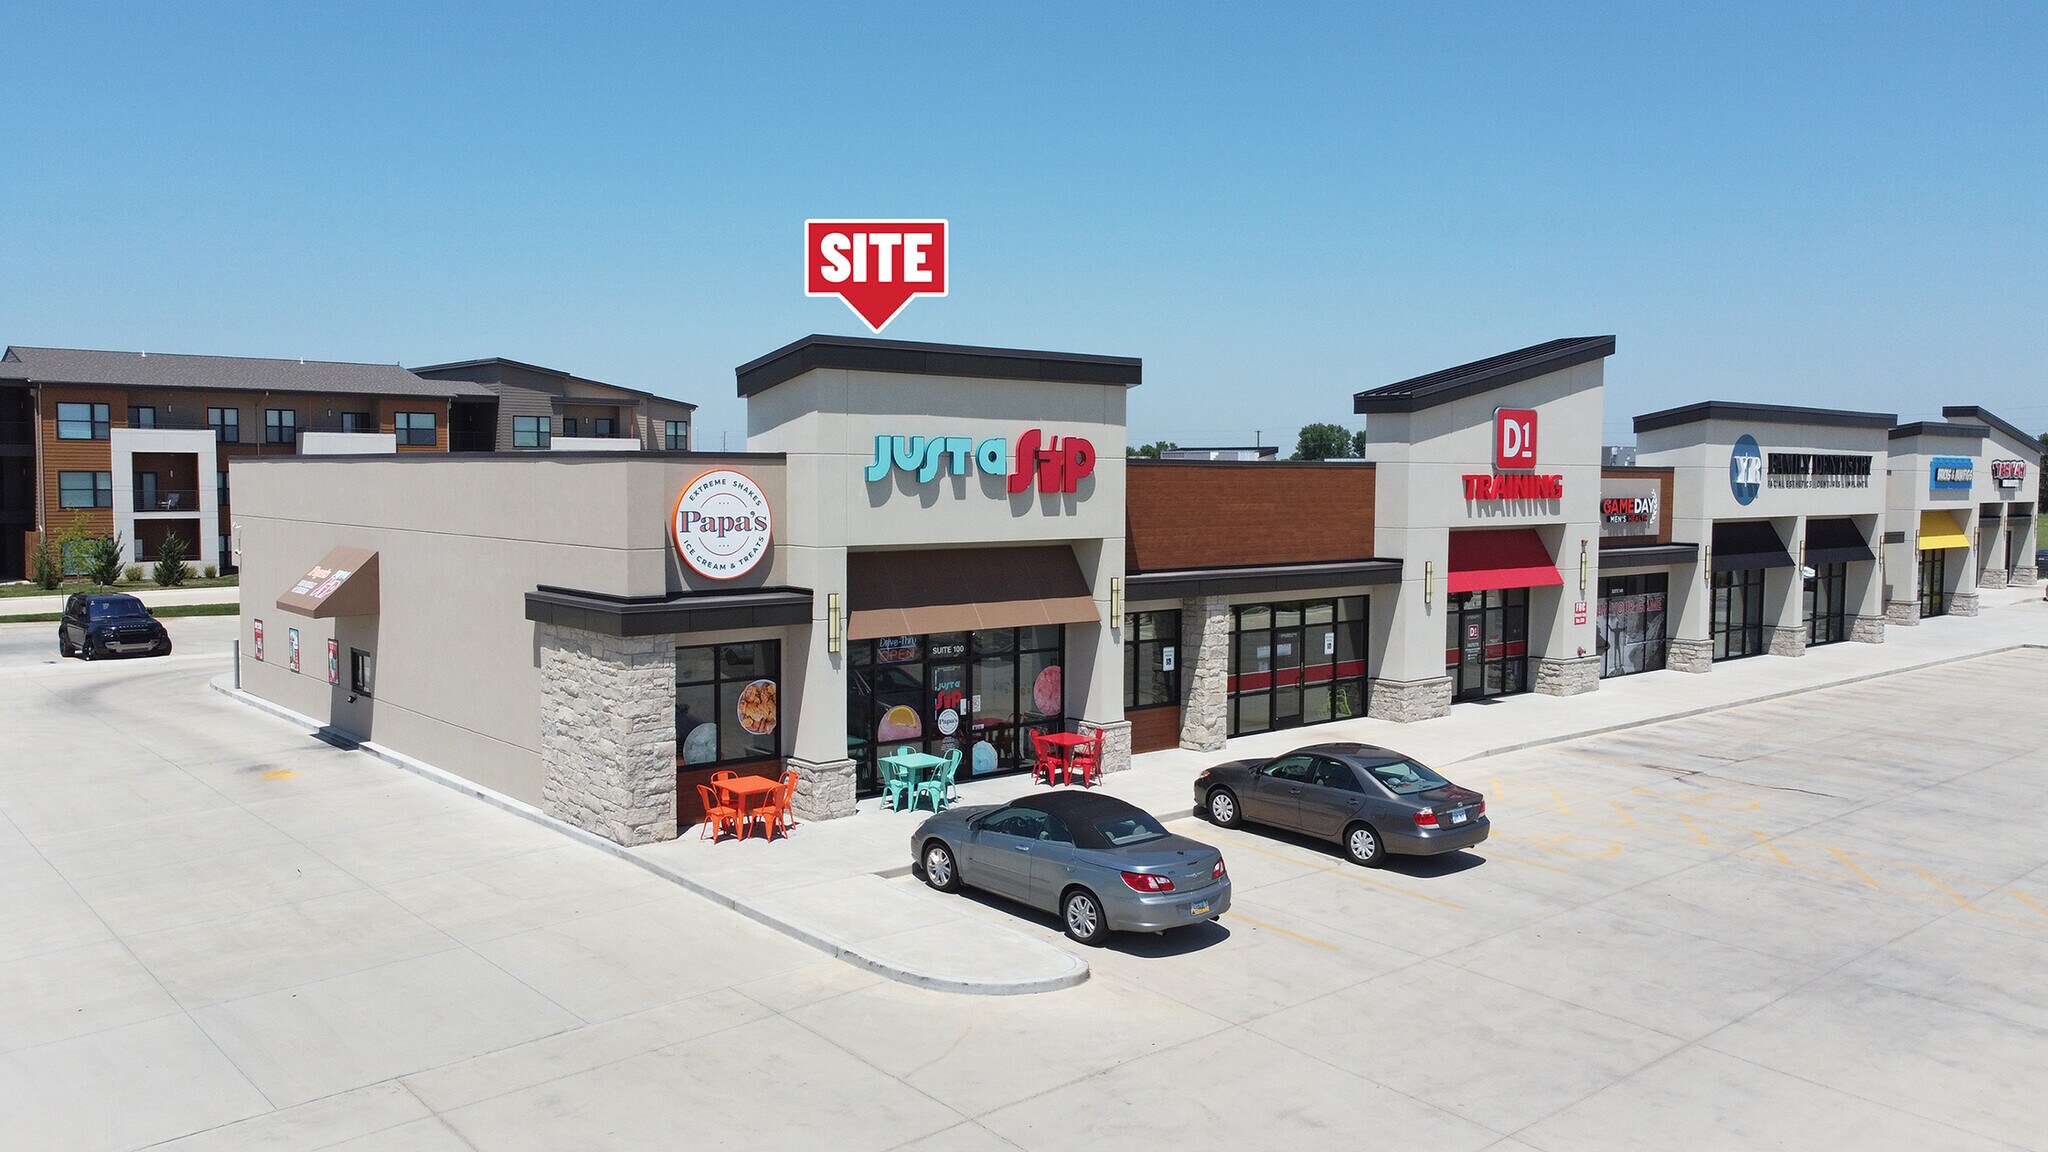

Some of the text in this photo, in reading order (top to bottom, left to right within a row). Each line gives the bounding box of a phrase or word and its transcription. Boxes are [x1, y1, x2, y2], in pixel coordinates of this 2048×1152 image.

[1503, 419, 1532, 458] D1
[864, 435, 973, 484] JUST
[1008, 429, 1096, 493] SIP
[1767, 453, 1873, 476] FAMILY DENTISTRY
[689, 478, 762, 507] EXTREME SHAKES
[1461, 474, 1563, 500] TRAINING
[1603, 498, 1654, 514] GAMEDAY
[679, 510, 768, 538] Papa's
[683, 536, 765, 571] ICE CREAM & TREATS
[880, 648, 916, 661] OPEN
[932, 645, 965, 655] SUITE 100
